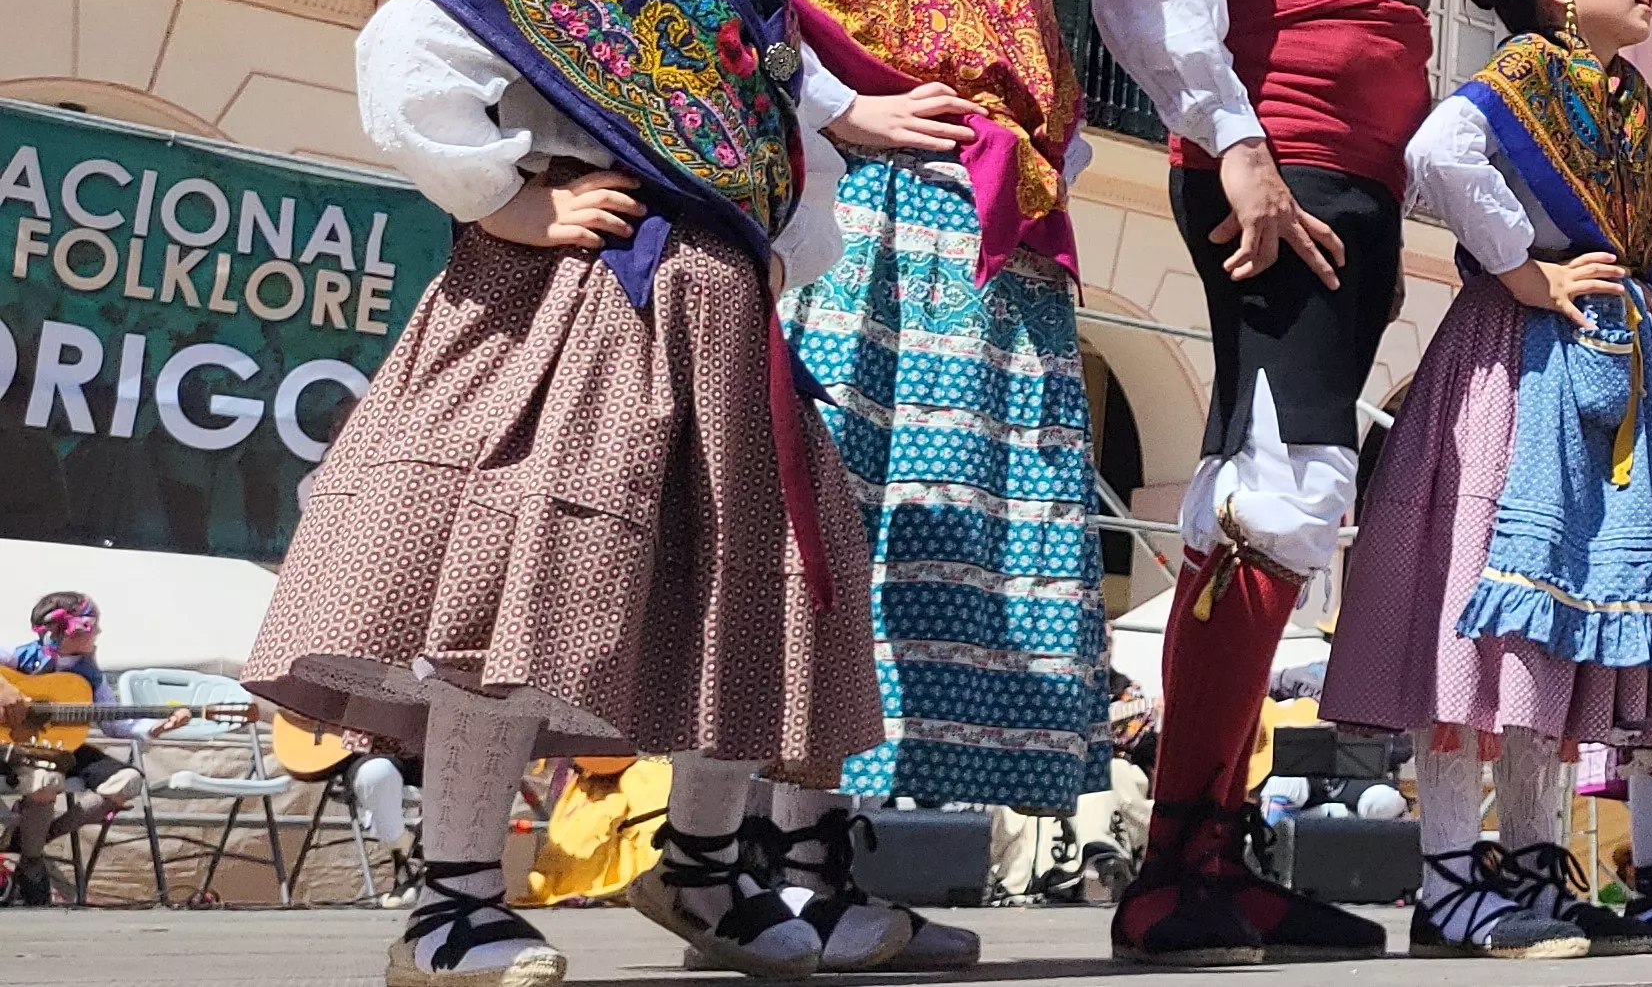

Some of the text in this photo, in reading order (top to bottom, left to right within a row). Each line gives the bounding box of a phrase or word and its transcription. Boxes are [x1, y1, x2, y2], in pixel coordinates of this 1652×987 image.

[0, 146, 396, 278] ACIONAL
[12, 217, 394, 335] FOLKLORE
[0, 319, 371, 463] RIGO
